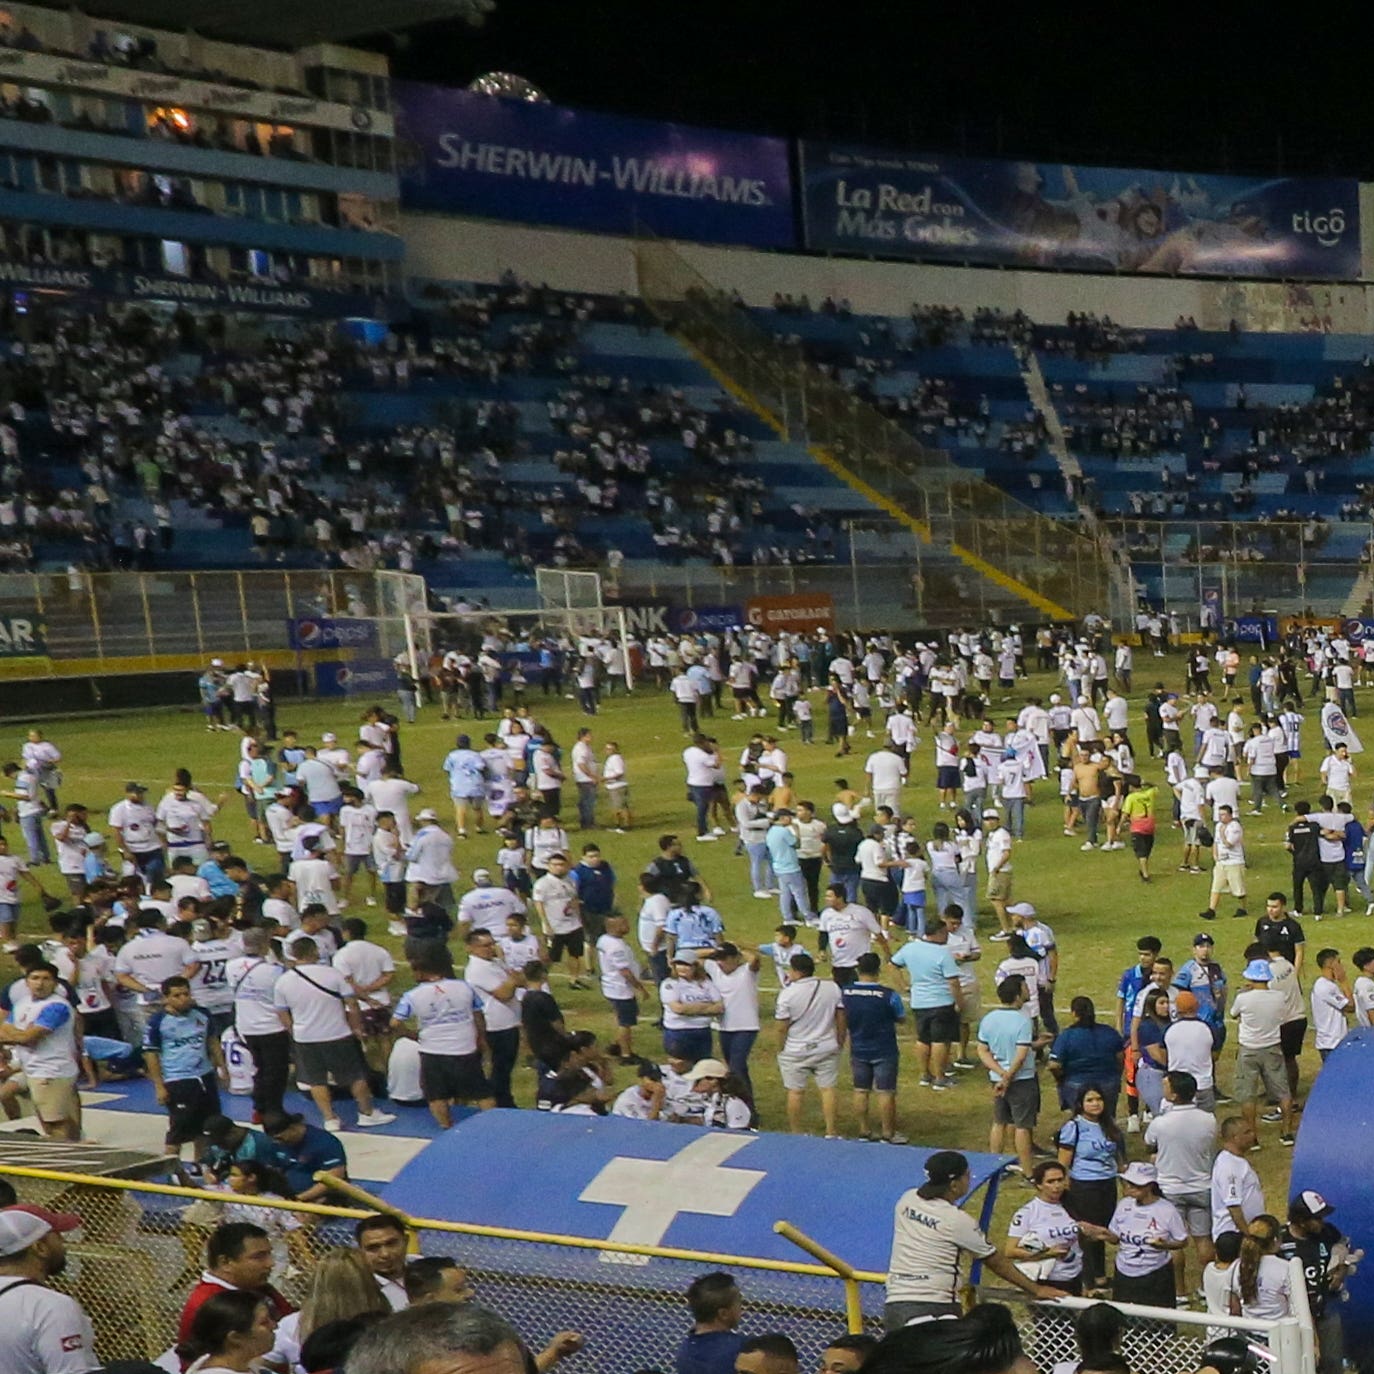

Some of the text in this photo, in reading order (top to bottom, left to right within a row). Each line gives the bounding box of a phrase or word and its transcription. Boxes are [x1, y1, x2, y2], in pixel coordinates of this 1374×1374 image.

[437, 132, 766, 206] SHERWIN-WILLIAMS
[836, 179, 871, 208] La
[878, 184, 931, 214] Red
[1239, 623, 1271, 641] pepi
[902, 1206, 941, 1231] ABANK
[1147, 1217, 1158, 1231] A
